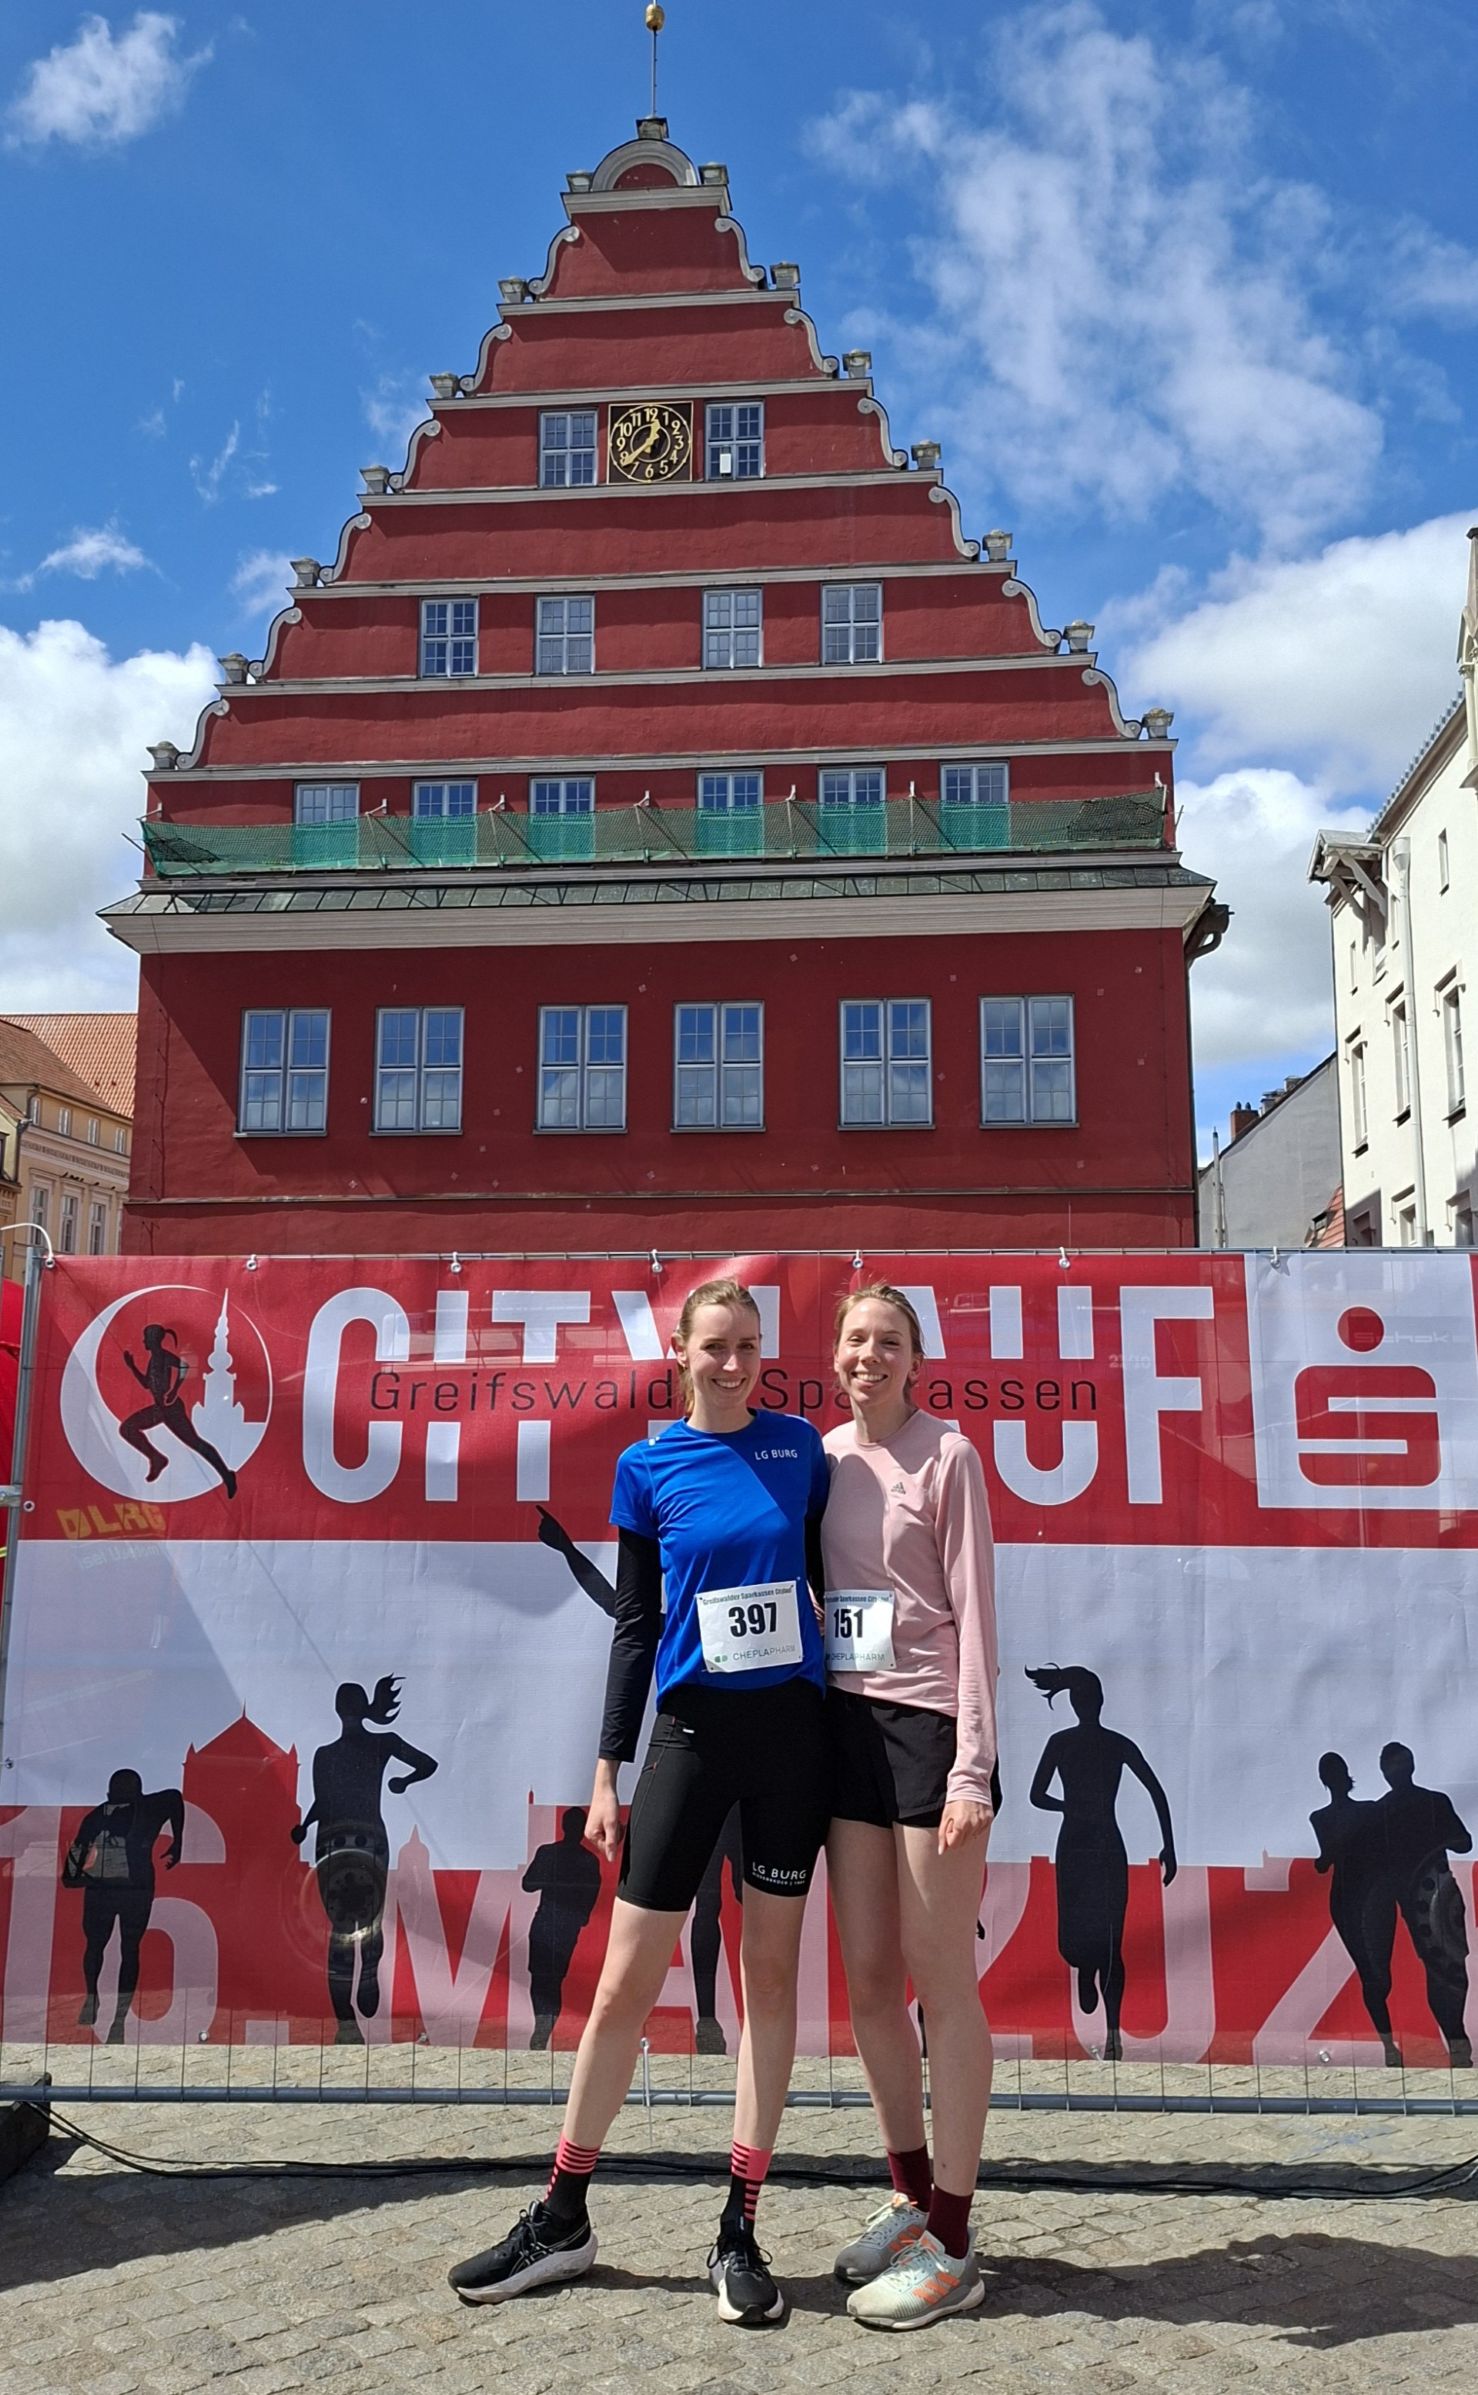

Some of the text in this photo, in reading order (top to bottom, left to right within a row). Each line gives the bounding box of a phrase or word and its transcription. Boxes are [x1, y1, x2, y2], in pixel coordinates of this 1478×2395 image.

[631, 413, 641, 427] 11
[644, 408, 658, 422] 12
[662, 412, 669, 426] 1
[619, 422, 632, 437] 10
[671, 420, 681, 435] 2
[616, 437, 626, 452] 9
[675, 435, 684, 450] 3
[669, 450, 678, 464] 4
[645, 463, 654, 478] 6
[660, 460, 668, 475] 5
[303, 1286, 1214, 1506] CITUF
[370, 1368, 1097, 1415] Greifswald Spaassen
[754, 1449, 798, 1460] LG BURG
[728, 1601, 778, 1638] 397
[833, 1608, 864, 1638] 151
[732, 1645, 796, 1661] CHEPLAPHARM
[752, 1861, 766, 1875] LG
[771, 1868, 808, 1880] BURG
